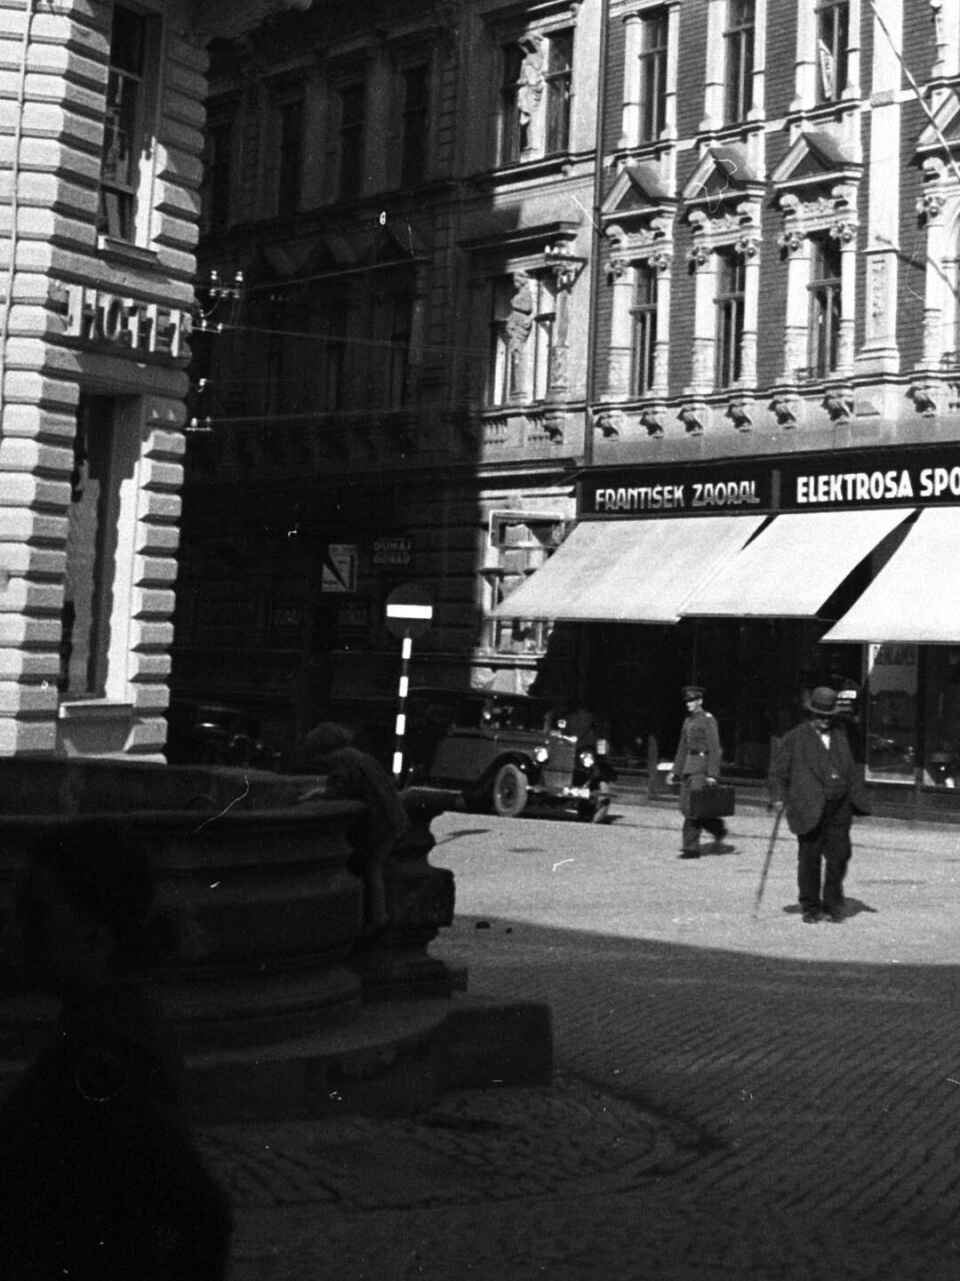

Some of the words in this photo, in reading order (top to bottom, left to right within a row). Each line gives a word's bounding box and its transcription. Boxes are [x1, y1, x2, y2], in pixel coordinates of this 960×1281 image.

[81, 288, 192, 358] HOTEL
[595, 483, 685, 511] FRANTIŠEK
[691, 480, 761, 507] ZAORAL
[797, 469, 914, 503] ELEKTROSA
